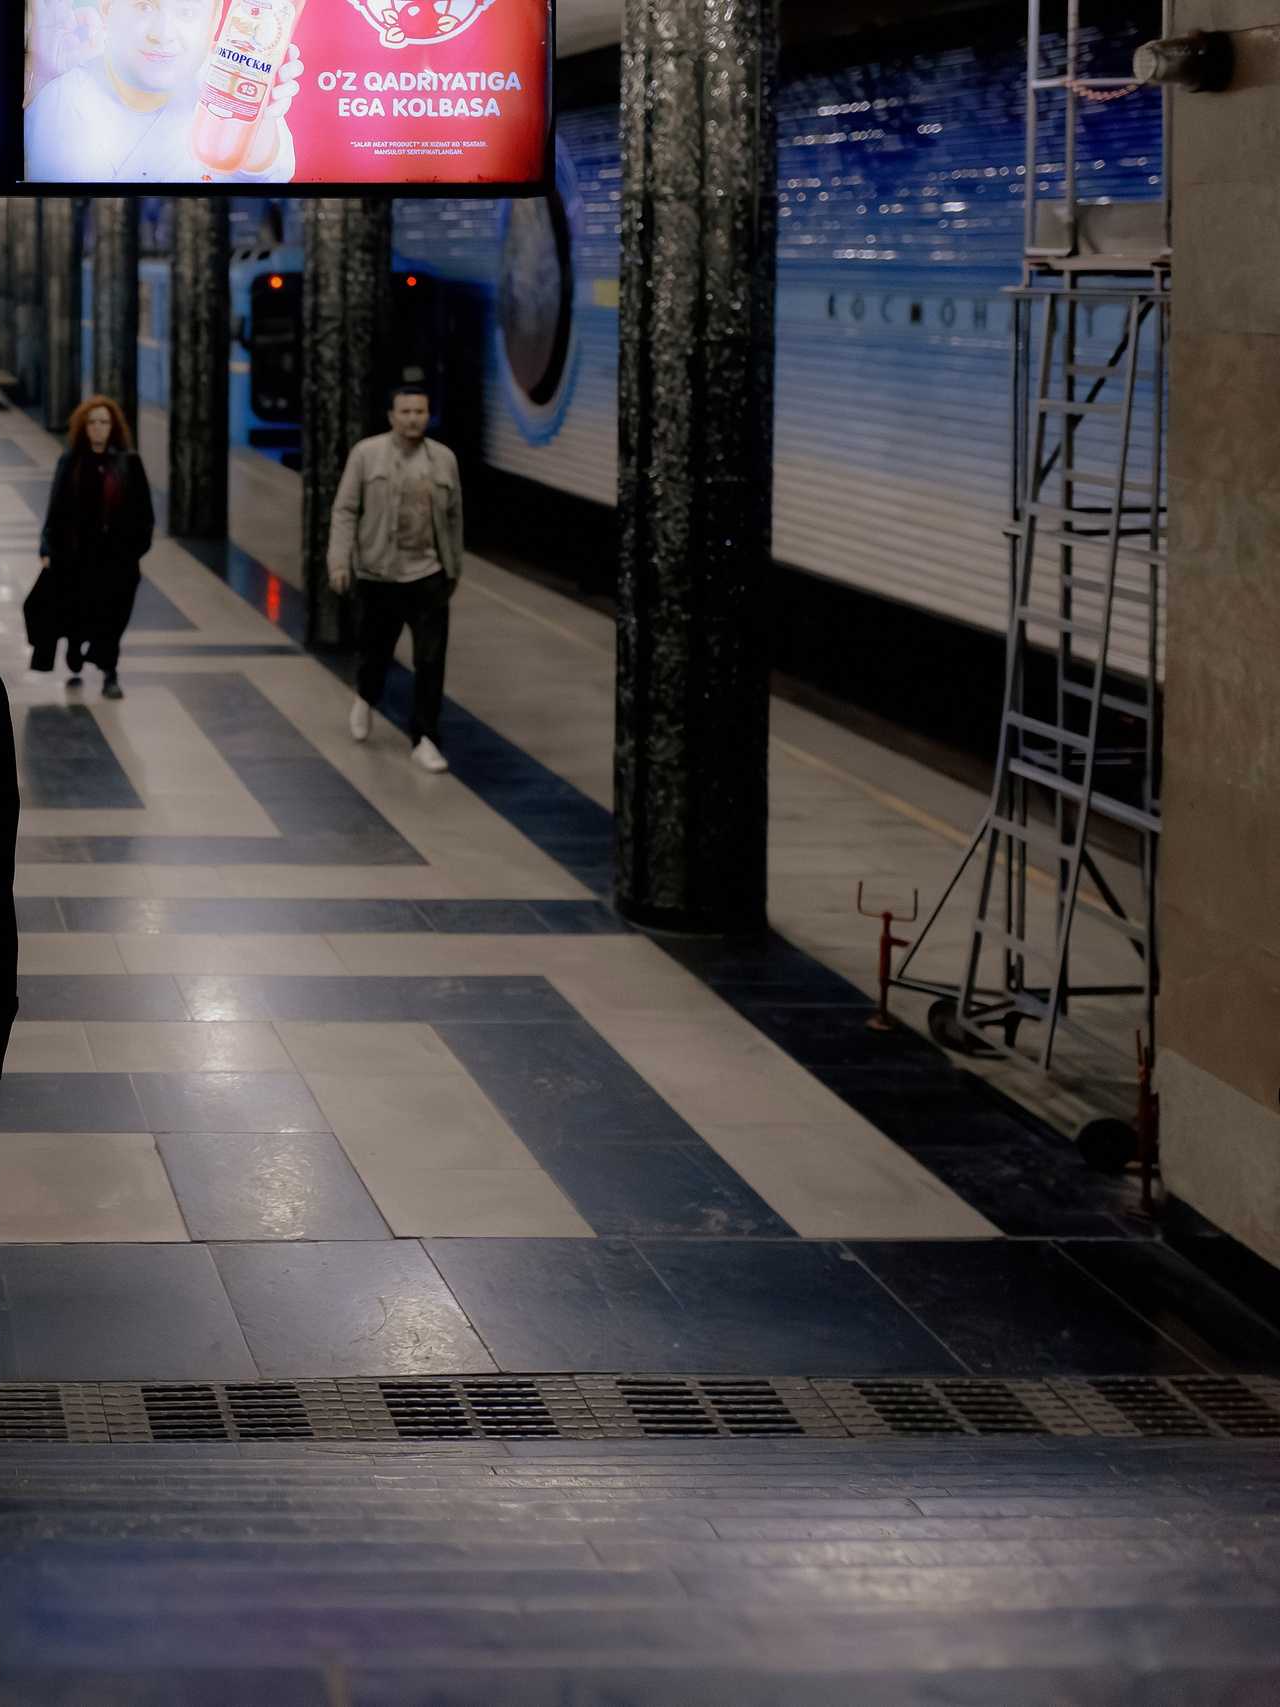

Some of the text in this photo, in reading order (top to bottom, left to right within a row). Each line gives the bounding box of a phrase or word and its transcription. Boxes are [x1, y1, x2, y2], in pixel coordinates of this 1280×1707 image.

[240, 84, 256, 96] 15
[317, 69, 522, 92] O'Z QADRIYATIGA
[338, 97, 501, 117] EGA KOLBASA
